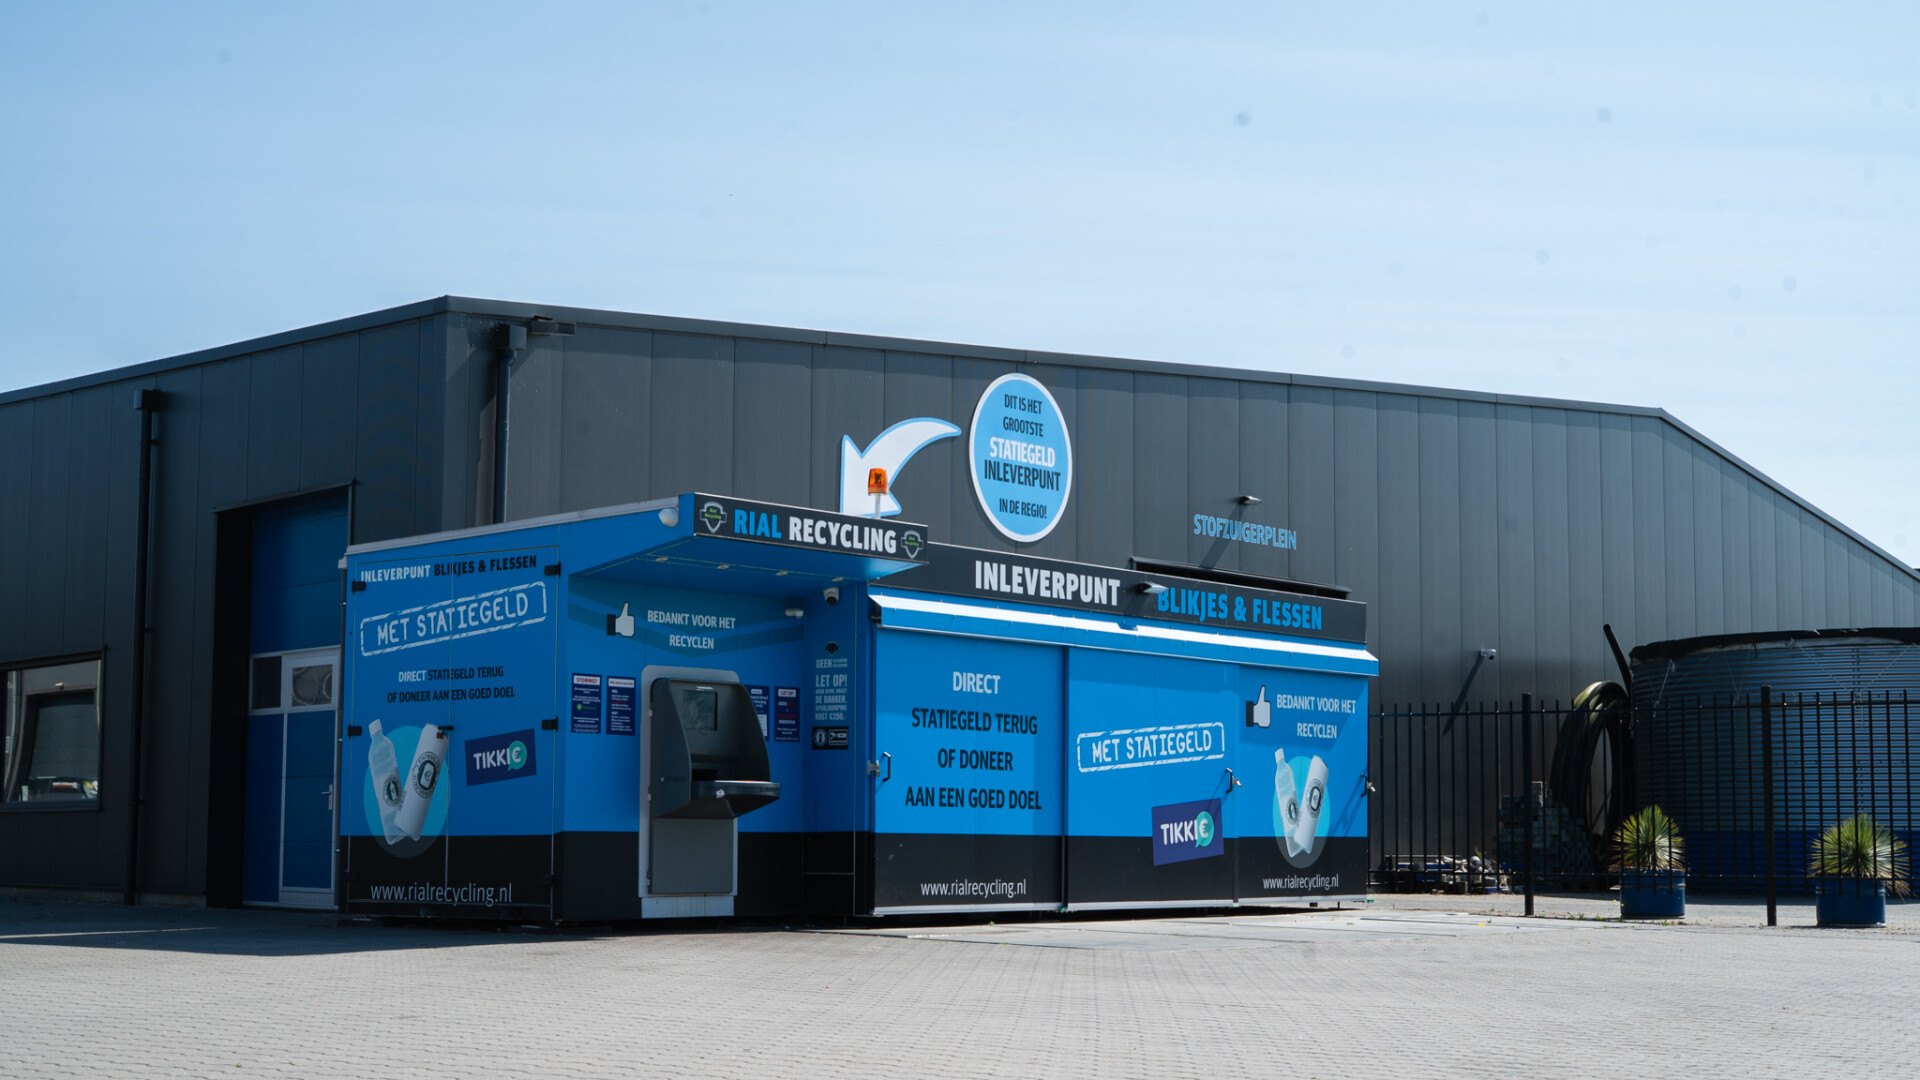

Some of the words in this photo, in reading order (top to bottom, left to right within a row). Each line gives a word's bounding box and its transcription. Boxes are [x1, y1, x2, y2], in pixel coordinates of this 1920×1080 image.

[1004, 394, 1018, 410] DIT
[1019, 396, 1026, 412] IS
[1027, 398, 1042, 414] HET
[1003, 416, 1044, 437] GROOTSTE
[989, 436, 1056, 467] STATIEGELD
[984, 459, 1061, 491] INLEVERPUNT
[999, 498, 1008, 513] IN
[1009, 500, 1020, 515] DE
[1021, 502, 1047, 519] REGIO!
[734, 509, 782, 539] RIAL
[789, 516, 897, 554] RECYCLING
[1193, 513, 1297, 550] STOFZUIGERPLEIN
[360, 565, 431, 582] INLEVERPUNT
[434, 561, 474, 577] BLIKJES
[478, 560, 487, 573] &
[490, 555, 537, 571] FLESSEN
[975, 560, 1121, 606] INLEVERPUNT
[1157, 586, 1229, 623] BLIKJES
[1233, 596, 1247, 623] &
[1252, 598, 1323, 631] FLESSEN
[377, 618, 409, 646] MET
[417, 592, 529, 637] STATIEGELD
[647, 610, 690, 626] BEDANKT
[691, 614, 718, 628] VOOR
[719, 616, 736, 629] HET
[669, 634, 714, 650] RECYCLEN
[398, 670, 427, 683] DIRECT
[427, 667, 474, 681] STATIEGELD
[477, 666, 504, 679] TERUG
[815, 674, 831, 688] LET
[833, 673, 848, 688] OP!
[952, 671, 1001, 695] DIRECT
[387, 692, 397, 703] OF
[399, 690, 431, 702] DONEER
[432, 689, 450, 701] AAN
[451, 688, 467, 700] EEN
[468, 687, 491, 699] GOED
[493, 686, 515, 699] DOEL
[1276, 694, 1316, 711] BEDANKT
[1317, 697, 1340, 713] VOOR
[1341, 699, 1356, 714] HET
[911, 707, 992, 732] STATIEGELD
[995, 712, 1038, 735] TERUG
[1297, 722, 1337, 739] RECYCLEN
[1092, 738, 1120, 764] MET
[1126, 730, 1212, 760] STATIEGELD
[937, 748, 956, 768] OF
[959, 749, 1014, 771] DONEER
[905, 786, 935, 807] AAN
[939, 787, 965, 808] EEN
[968, 788, 1005, 809] GOED
[1008, 790, 1042, 810] DOEL
[920, 878, 1027, 899] www.rialrecycling.nl
[1262, 873, 1339, 891] www.rialrecycling.nl
[370, 881, 512, 907] www.rialrecycling.nl
